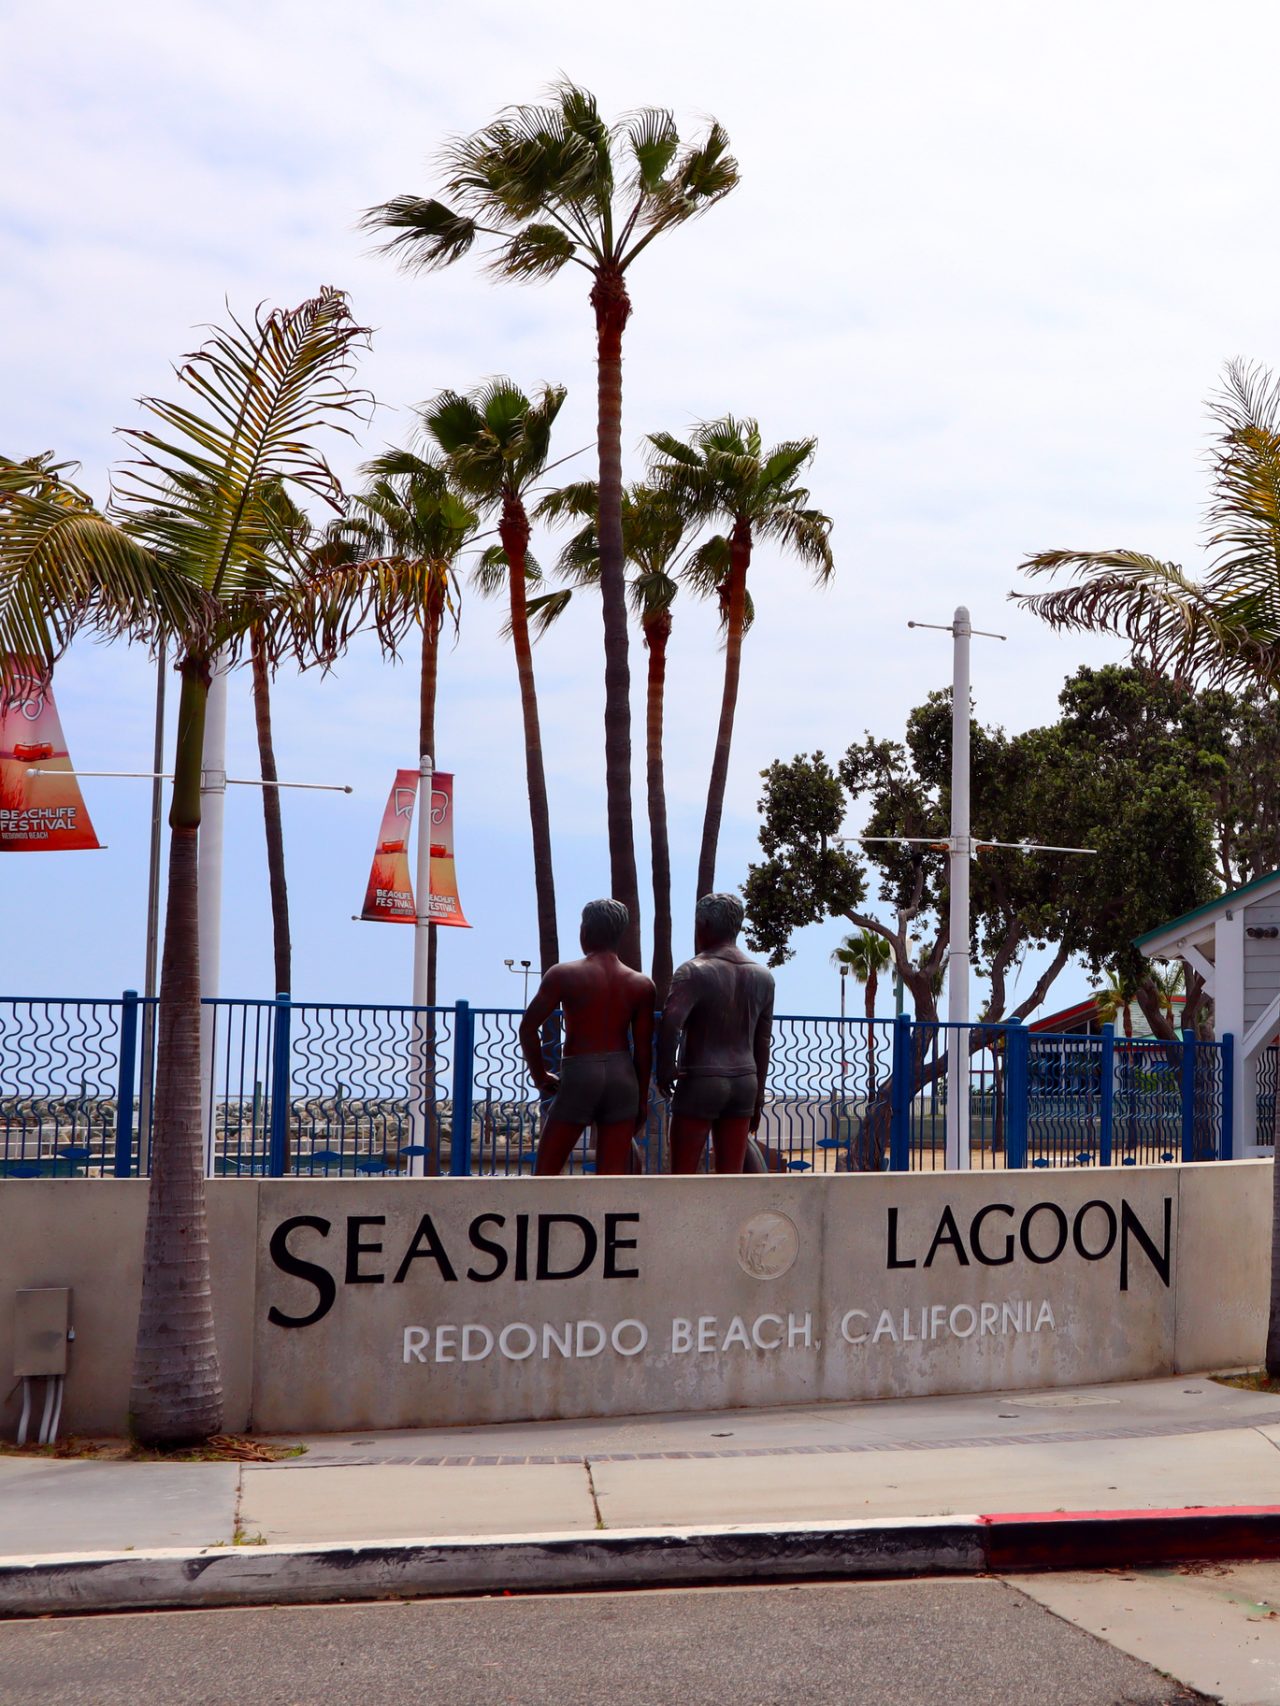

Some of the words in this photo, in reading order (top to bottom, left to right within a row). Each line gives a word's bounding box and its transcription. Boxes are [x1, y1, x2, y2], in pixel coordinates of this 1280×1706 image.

[0, 807, 76, 820] BEACHLIFE
[0, 818, 76, 832] FESTIVAL
[29, 831, 48, 840] BEACH
[376, 898, 413, 909] FESTIVAL
[429, 894, 455, 904] EACHLIFE
[268, 1213, 640, 1328] SEASIDE
[886, 1197, 1173, 1292] LAGOON
[403, 1318, 648, 1364] REDONDO
[841, 1298, 1057, 1345] CALIFORNIA
